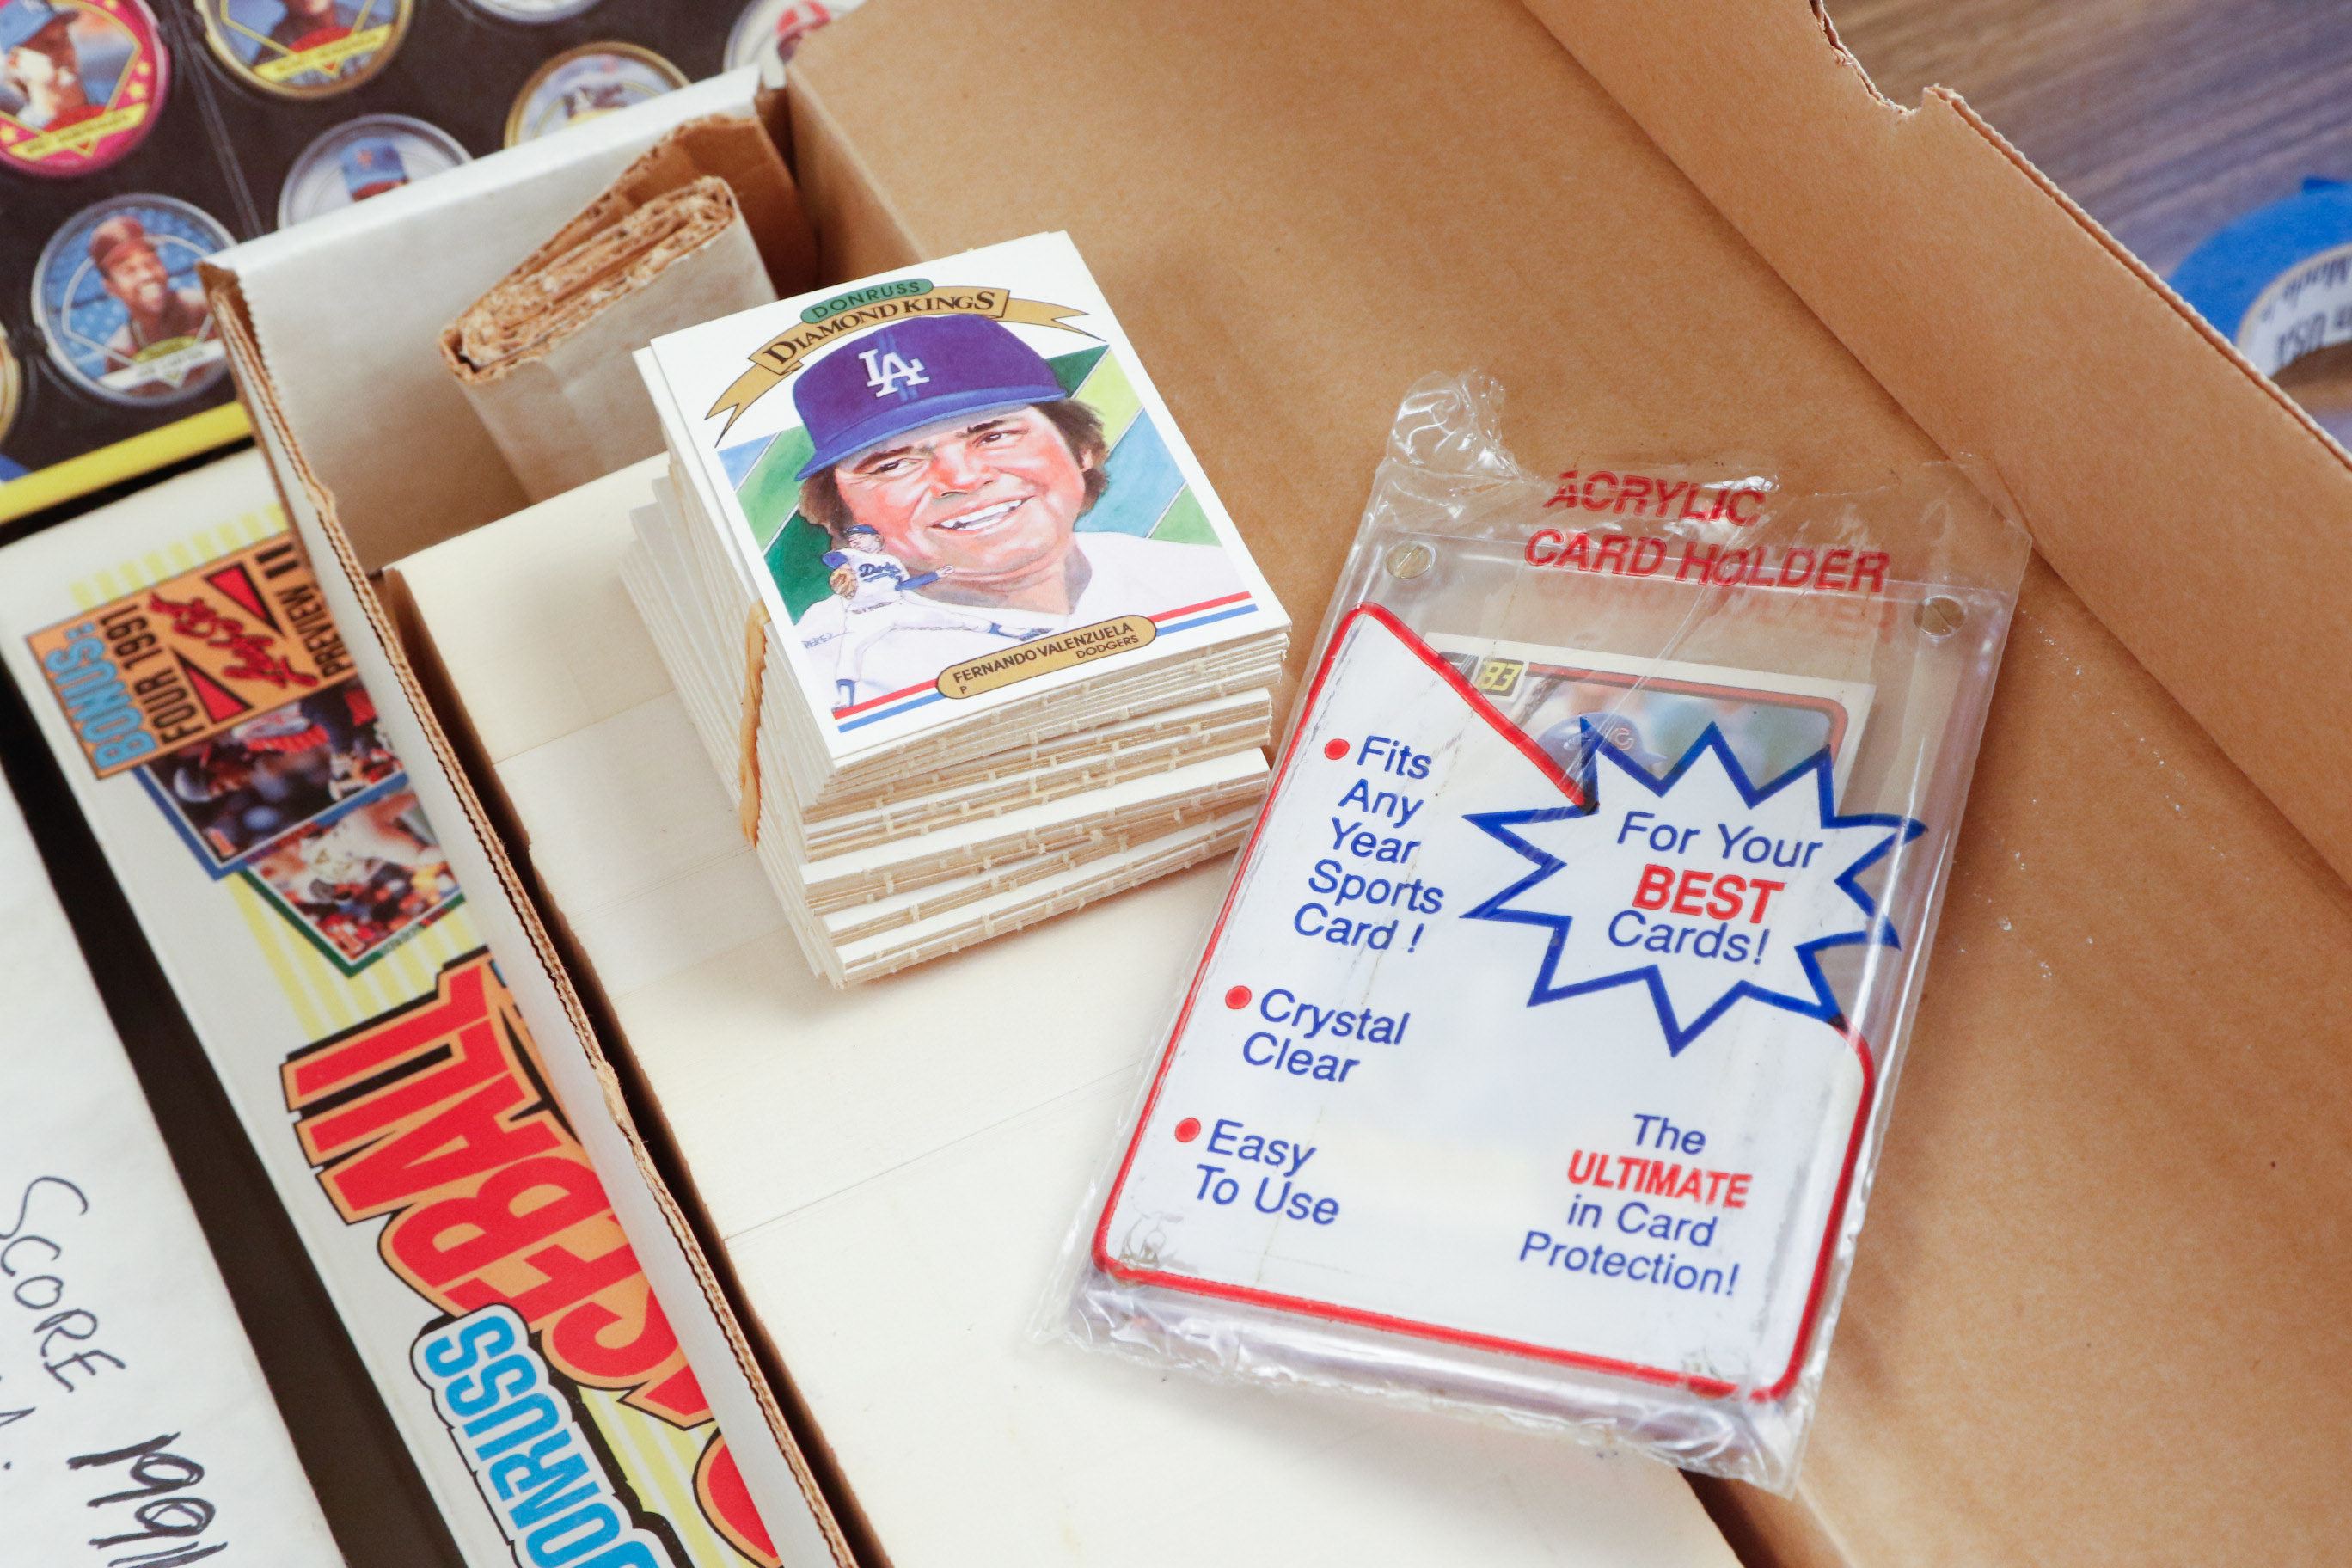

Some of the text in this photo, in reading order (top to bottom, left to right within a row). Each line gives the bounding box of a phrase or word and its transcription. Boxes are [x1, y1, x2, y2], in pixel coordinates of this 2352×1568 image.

[763, 291, 995, 364] DIAMOND KINGS
[816, 281, 921, 318] DONRUSS
[858, 348, 930, 398] LA
[1542, 469, 1767, 527] ACRYLIC
[1523, 528, 1890, 593] CARD HOLDER
[277, 584, 354, 678] PREVIEW
[952, 622, 1134, 683] FERNANDO VALENZUELA
[1075, 634, 1140, 659] DODGERS
[45, 621, 157, 769] BONUS:
[100, 603, 205, 744] FOUR 1991
[959, 685, 968, 695] P
[1356, 735, 1433, 780] Fits
[1338, 778, 1424, 829] Any
[1331, 816, 1421, 865] Year
[1617, 811, 1823, 870] For Your
[1308, 858, 1445, 915] Sports
[1632, 863, 1785, 925] BEST
[1293, 902, 1398, 952] Card
[1608, 910, 1771, 966] Cards!
[1259, 988, 1411, 1046] Crystal
[1241, 1032, 1360, 1085] Clear
[1206, 1118, 1317, 1178] Easy
[1633, 1113, 1706, 1155] The
[1196, 1164, 1341, 1226] To Use
[1566, 1149, 1753, 1210] ULTIMATE
[1567, 1194, 1718, 1249] in Card
[0, 1176, 126, 1393] SCORE
[1520, 1230, 1740, 1297] Protection!
